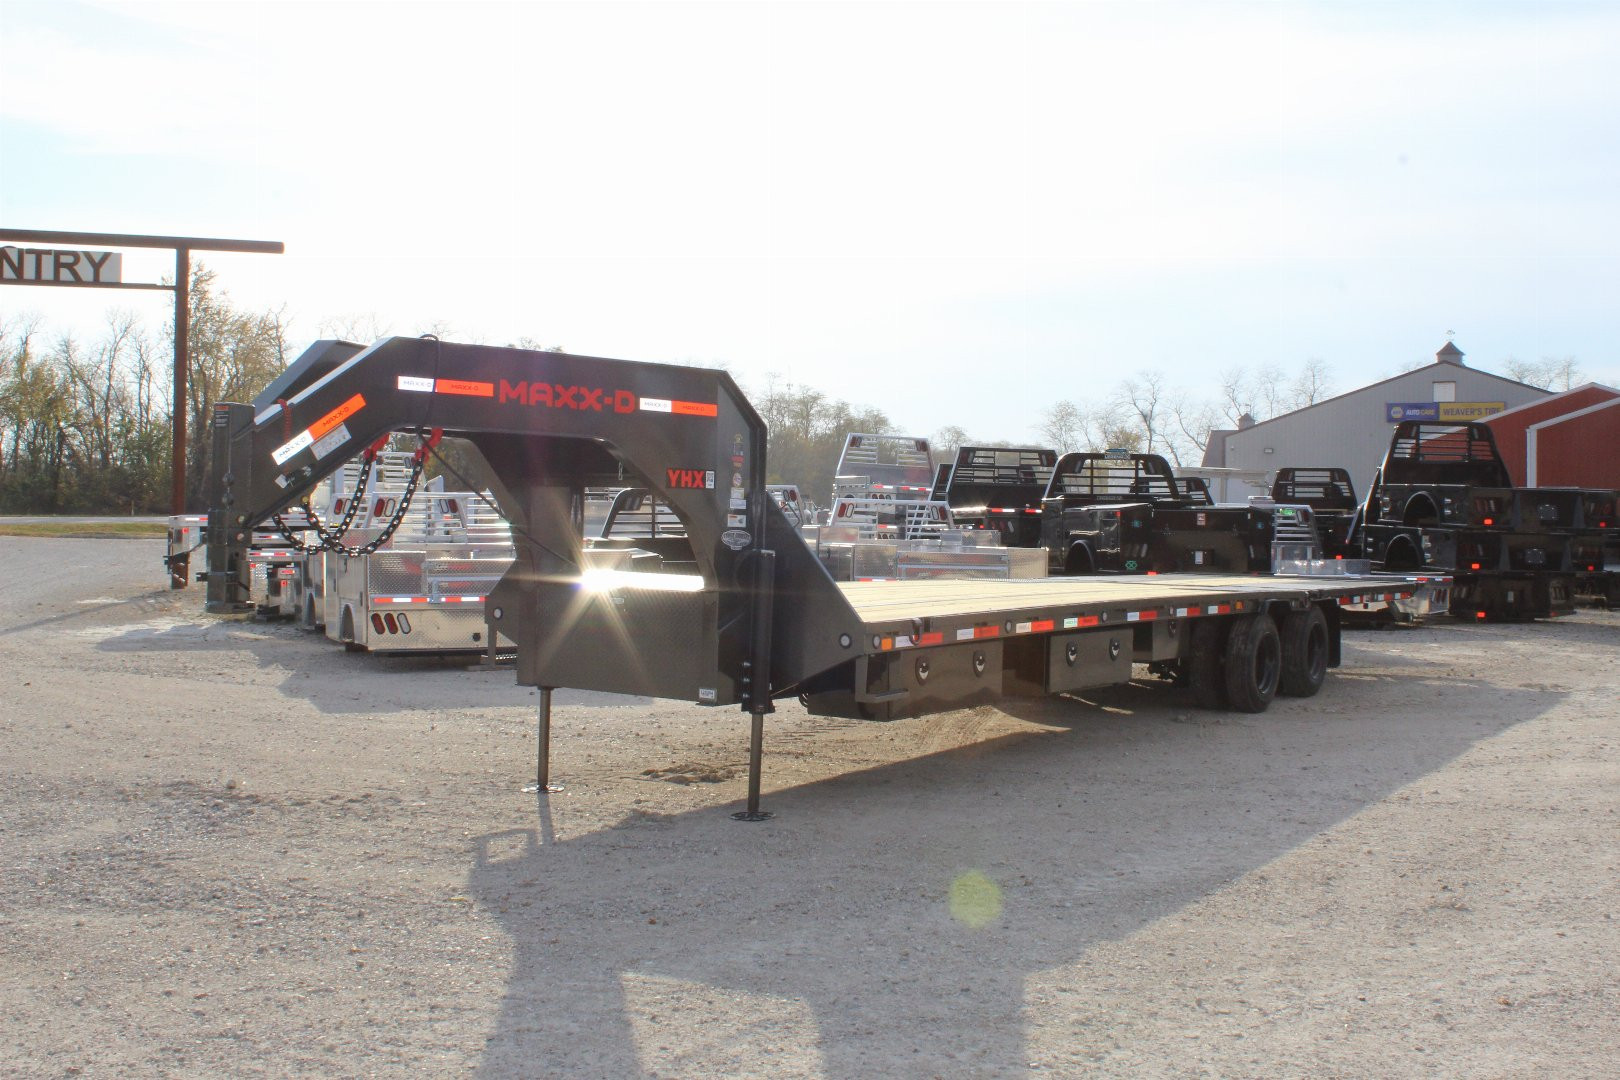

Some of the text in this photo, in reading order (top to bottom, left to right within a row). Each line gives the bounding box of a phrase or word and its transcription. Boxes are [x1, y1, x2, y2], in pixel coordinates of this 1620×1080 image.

[0, 247, 112, 281] NTRY
[499, 379, 636, 414] MAXX-D
[1443, 407, 1483, 416] WEAVER'S
[667, 469, 705, 488] YHX
